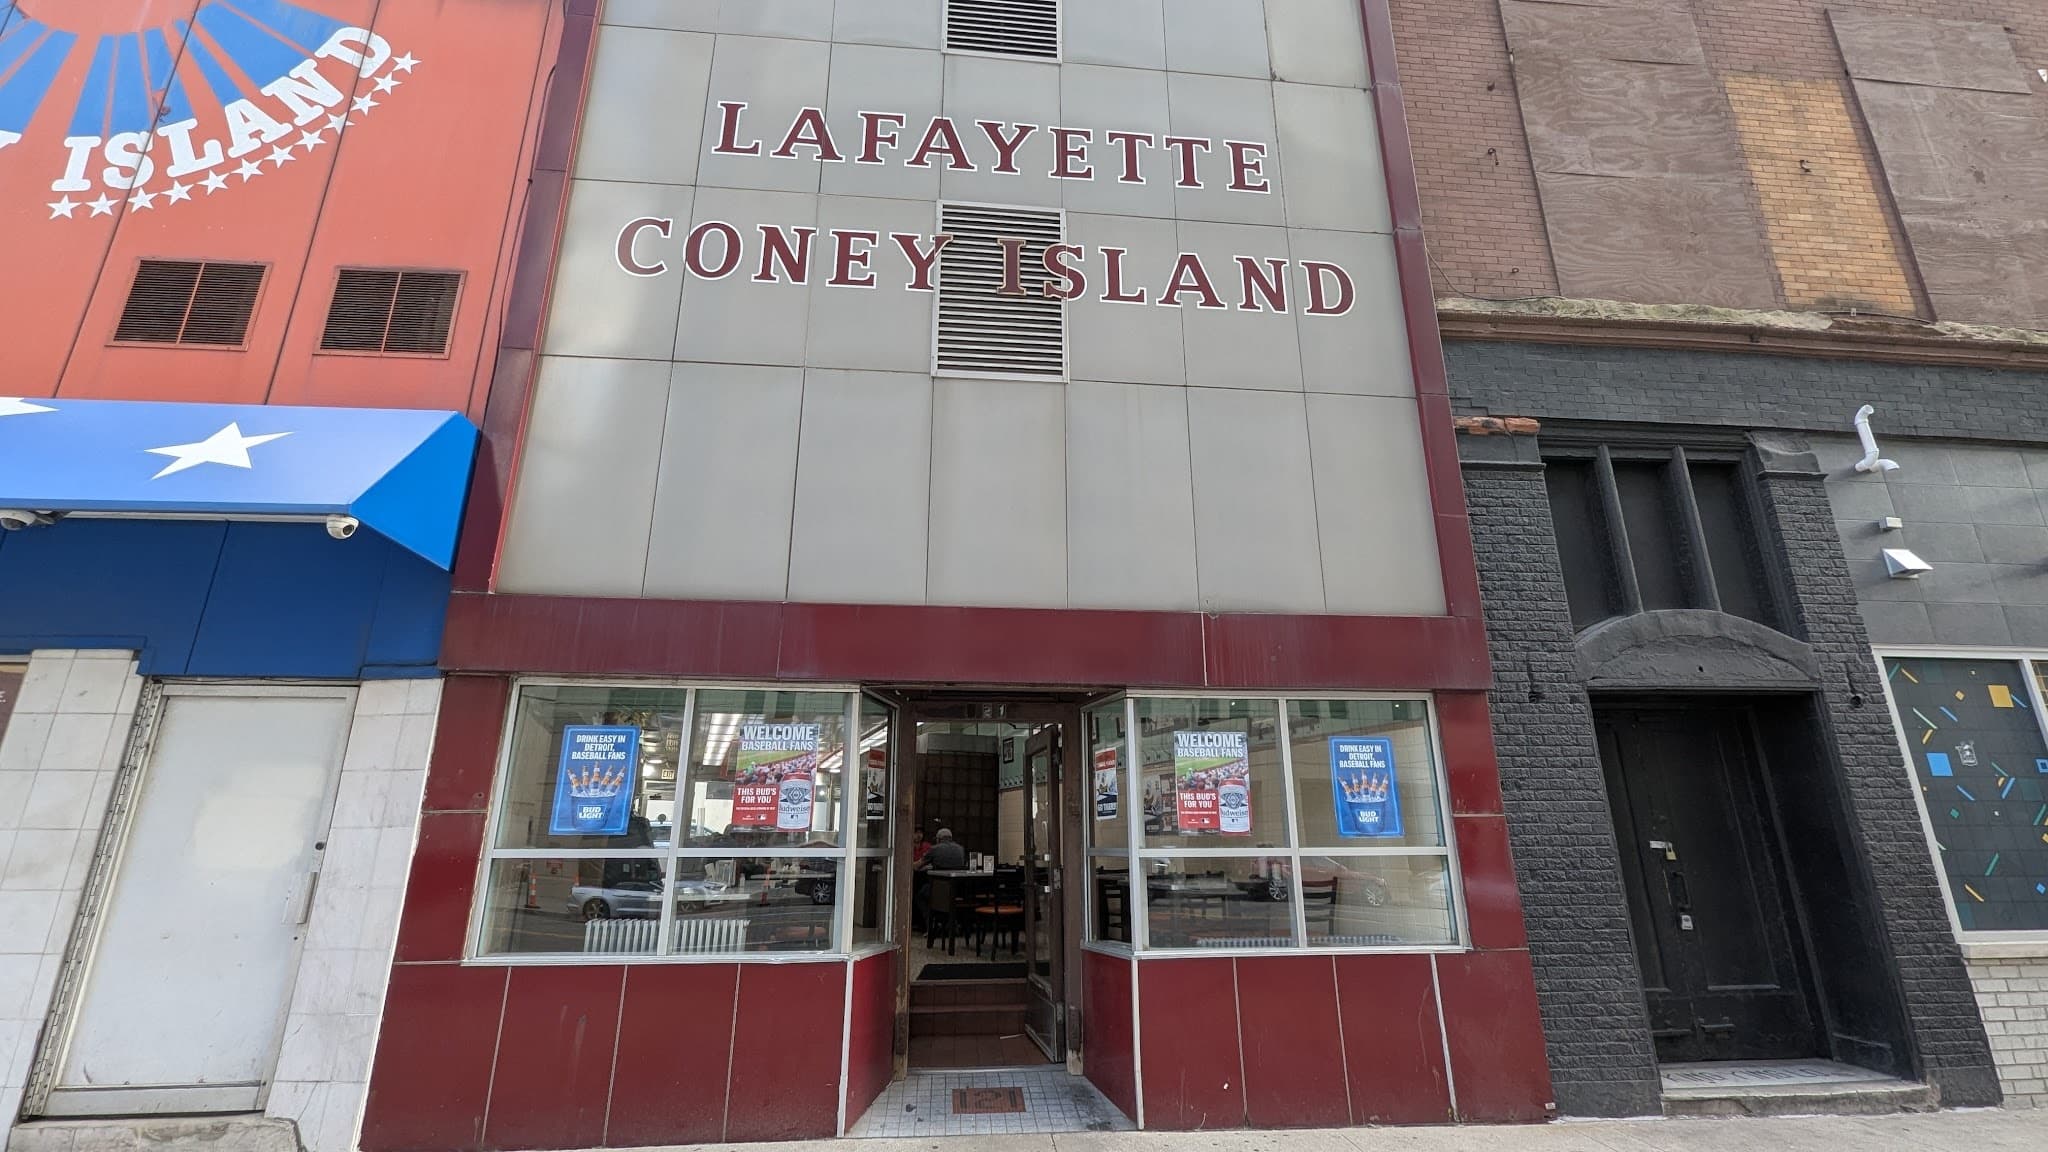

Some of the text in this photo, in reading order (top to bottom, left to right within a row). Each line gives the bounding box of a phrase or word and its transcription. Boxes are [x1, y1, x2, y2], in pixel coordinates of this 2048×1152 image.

[51, 26, 392, 192] ISLAND
[711, 101, 1271, 194] LAFAYETTE
[615, 216, 1355, 316] CONEY ISLAND
[743, 725, 814, 740] WELCOME
[576, 735, 626, 743] DRINK EASY IN
[1177, 733, 1243, 748] WELCOME
[741, 741, 814, 751] BASEBALL FANS
[1339, 745, 1382, 753] DRINK EASY IN
[571, 752, 626, 760] BASEBALL FANS
[1177, 748, 1243, 758] BASEBALL FANS
[1339, 760, 1386, 769] BASEBALL FANS
[737, 788, 777, 796] THIS BUD'S
[741, 796, 772, 804] FOR YOU
[1196, 793, 1216, 801] BUD'S
